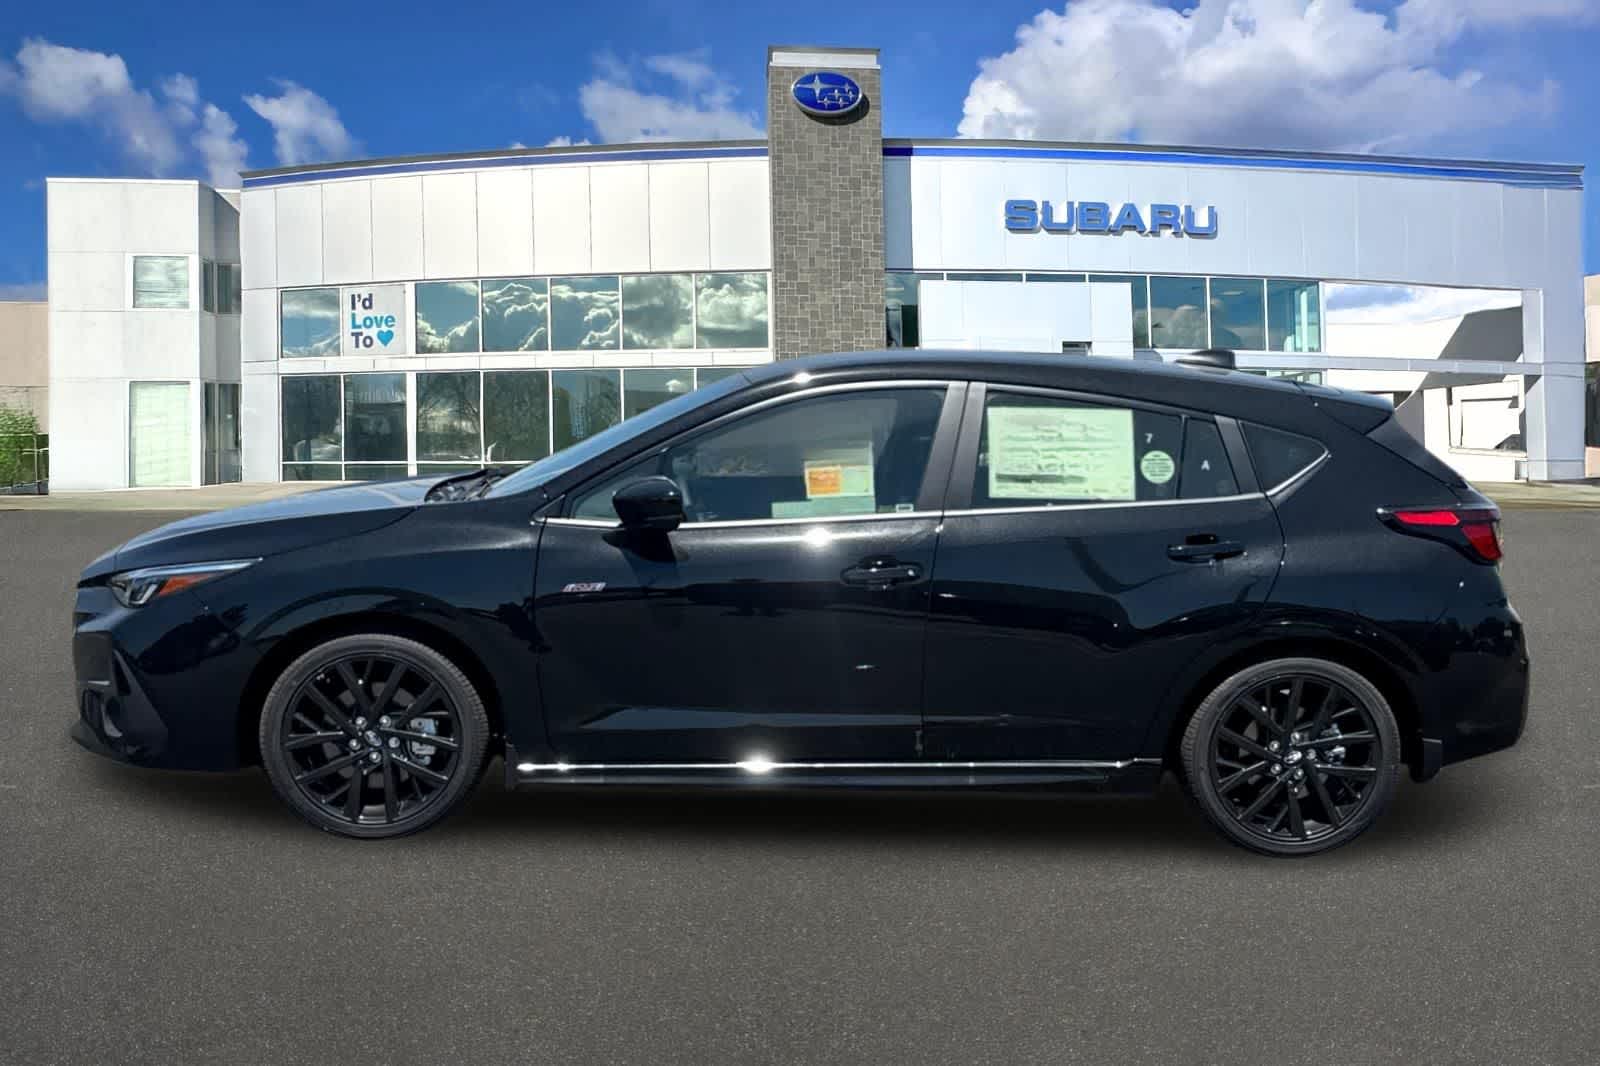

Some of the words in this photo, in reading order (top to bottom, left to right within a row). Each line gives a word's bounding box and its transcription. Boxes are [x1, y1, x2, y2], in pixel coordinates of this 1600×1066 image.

[1005, 199, 1217, 238] SUBARU
[351, 293, 373, 310] I'd
[351, 312, 396, 329] Love
[351, 331, 374, 348] To
[1144, 432, 1153, 444] 7
